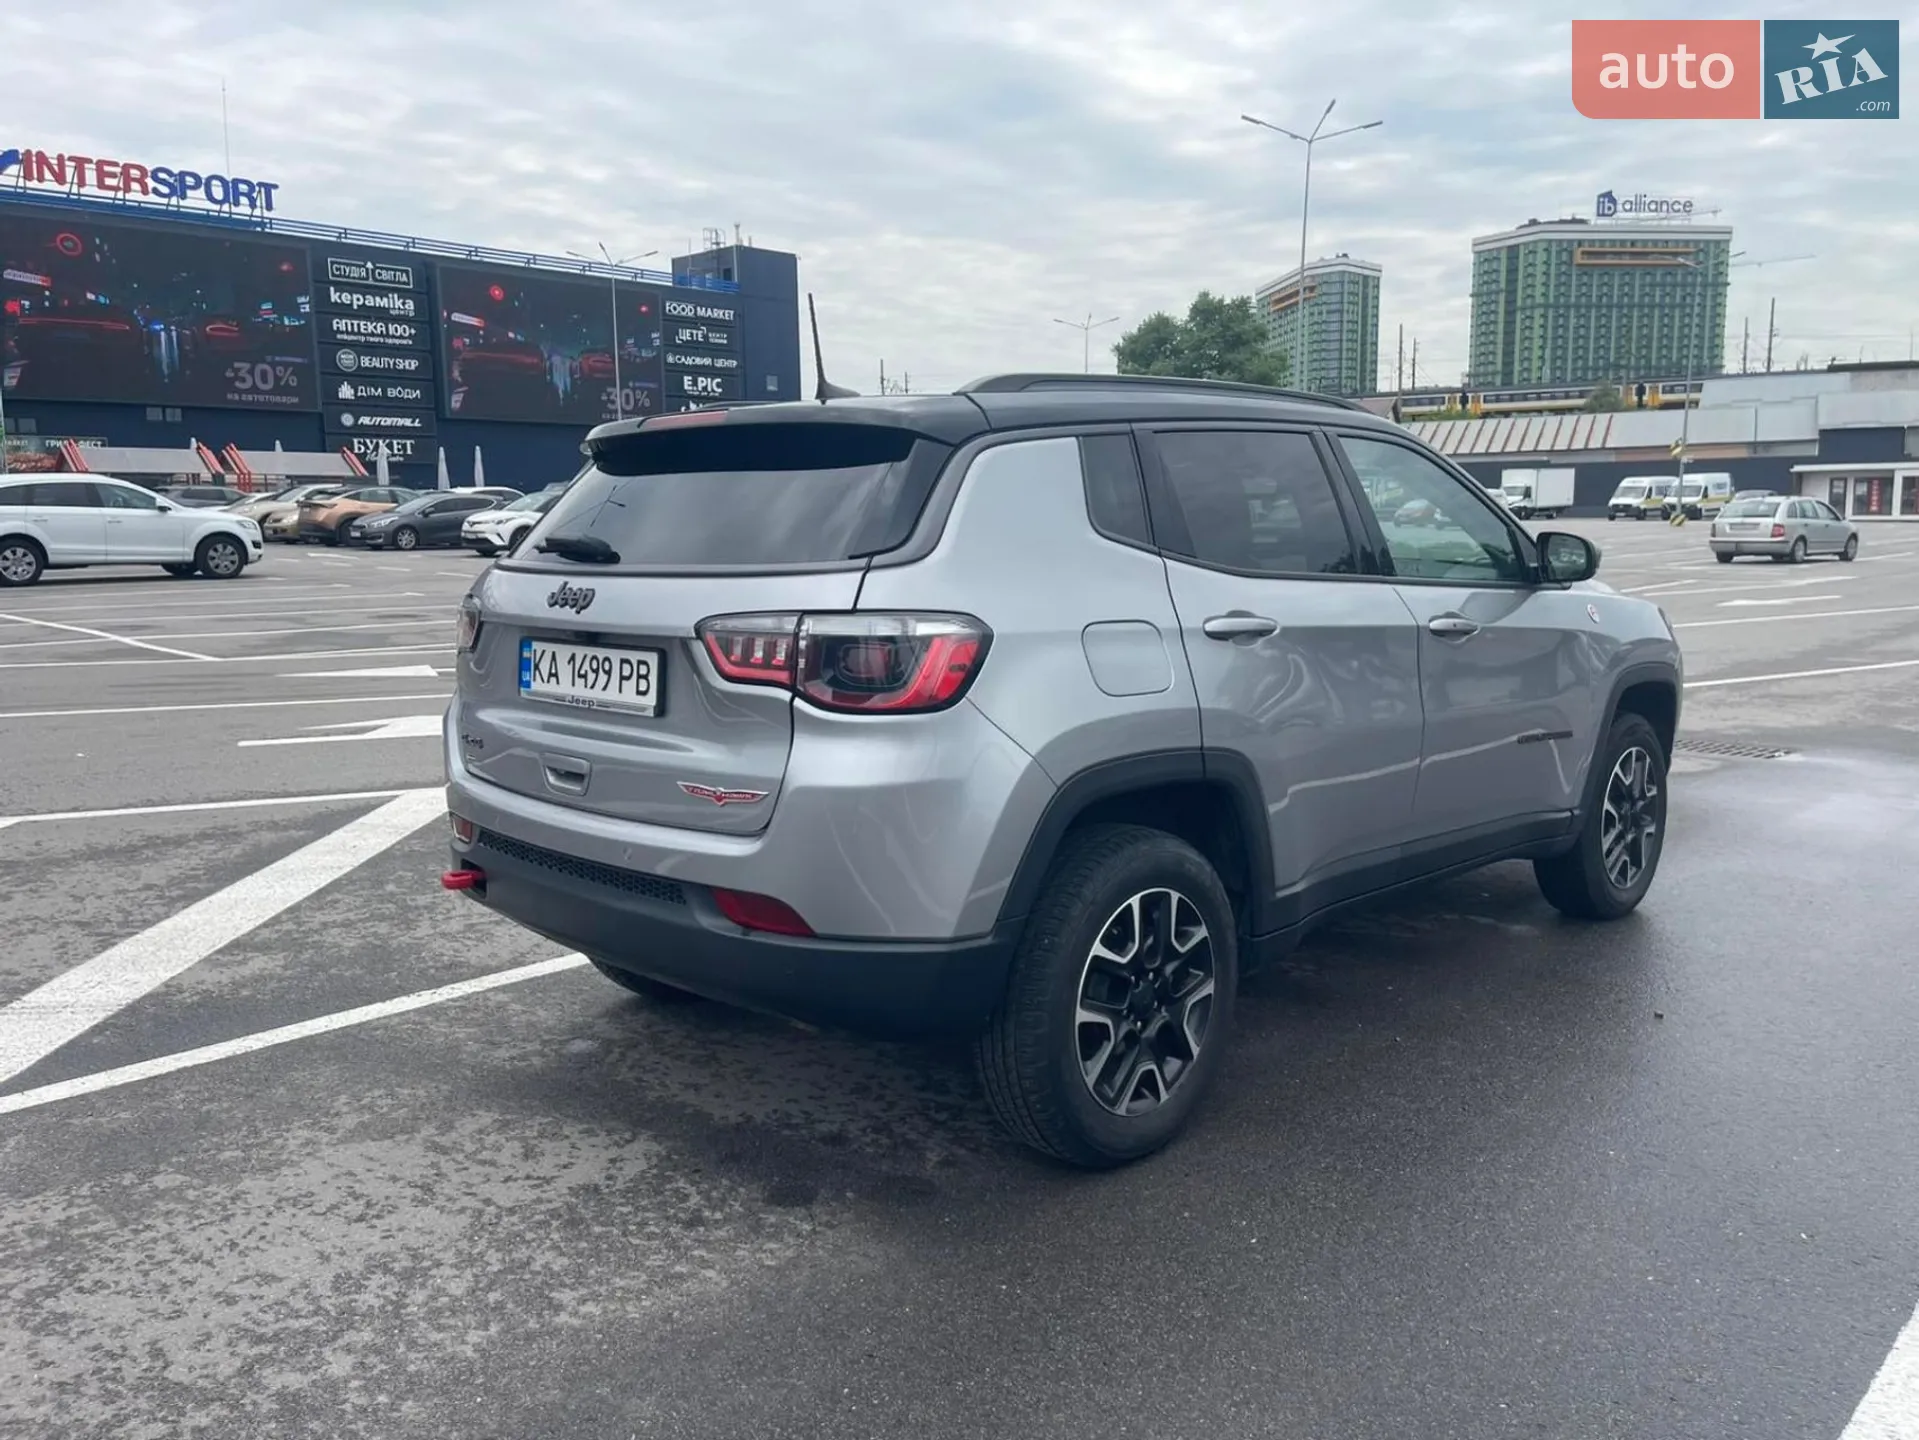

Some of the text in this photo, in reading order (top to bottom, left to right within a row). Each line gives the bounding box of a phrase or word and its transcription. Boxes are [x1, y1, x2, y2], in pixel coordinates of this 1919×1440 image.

[22, 149, 279, 211] INTERSPORT
[1622, 193, 1693, 213] alliance
[332, 264, 409, 283] СТУДІЯ СВІТЛА
[665, 301, 735, 321] FOOD MARKET
[332, 319, 416, 337] АПТЕКА 100+
[360, 355, 395, 369] BEAUTY
[395, 358, 418, 370] SHOP
[675, 355, 738, 369] САДОВИЙ ЦЕНТР
[357, 385, 421, 399] ДІМ ВОДИ
[683, 375, 723, 393] E.PIC
[357, 416, 422, 427] AUTOMALL
[352, 437, 415, 455] БУКЕТ
[547, 581, 596, 614] Jeep
[532, 648, 651, 696] KA 1499 PB
[566, 694, 596, 709] Jeep
